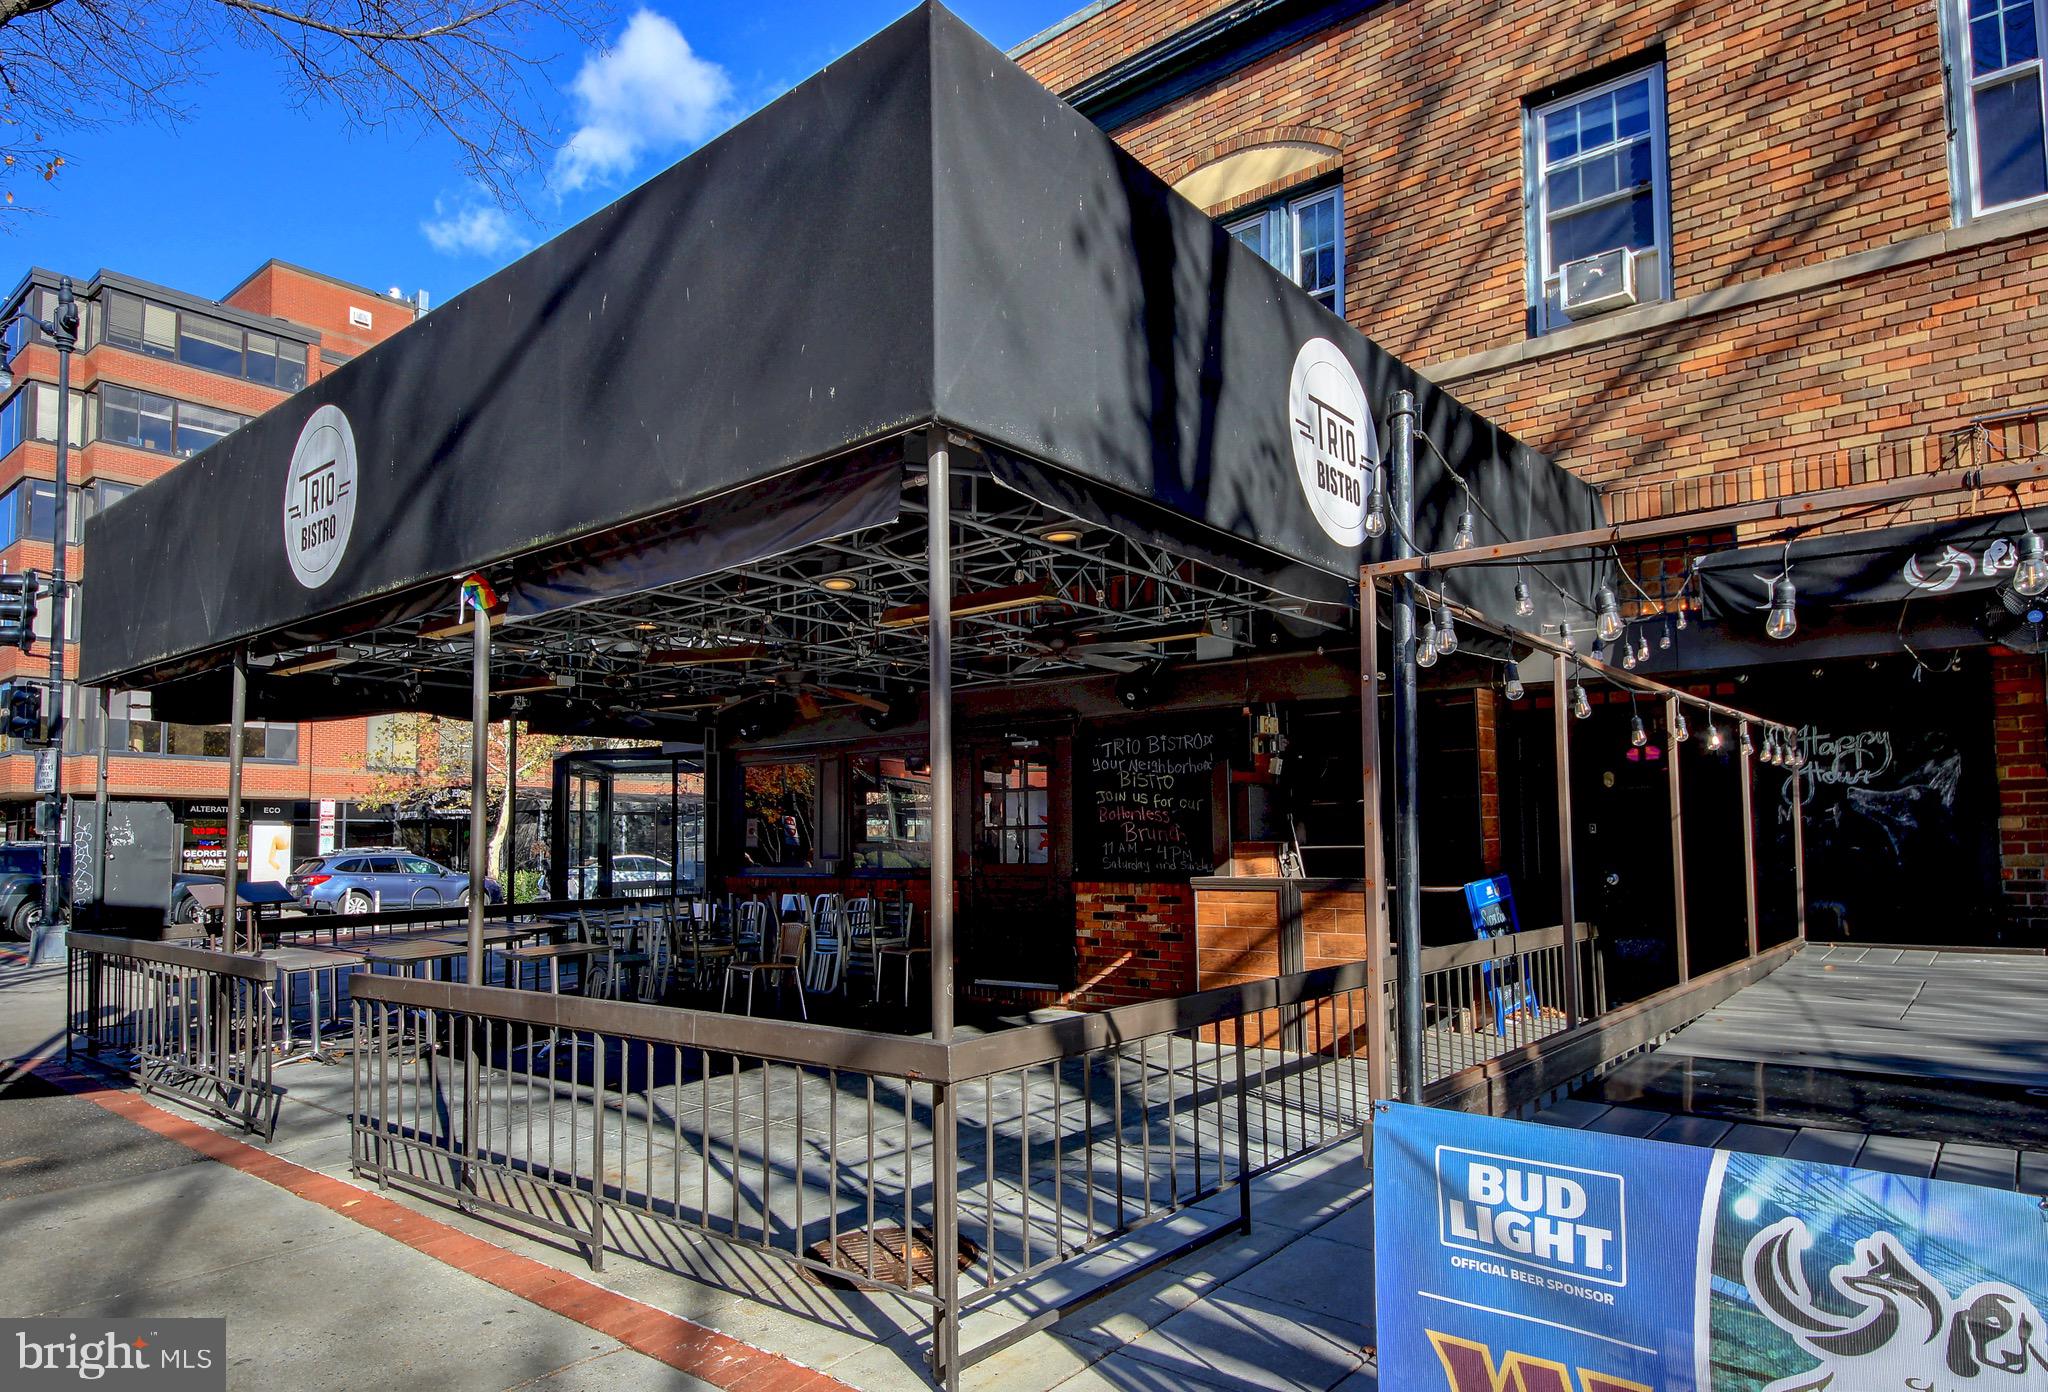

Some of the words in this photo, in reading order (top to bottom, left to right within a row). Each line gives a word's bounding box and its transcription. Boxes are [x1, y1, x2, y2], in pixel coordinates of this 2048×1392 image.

[1308, 393, 1356, 468] TRIO
[298, 459, 336, 517] TRIO
[1317, 459, 1361, 507] BISTRO
[301, 514, 336, 552] BISTRO
[1793, 724, 1893, 776] Happy
[190, 805, 245, 814] ALTERATIS
[263, 806, 281, 814] ECO
[1468, 1162, 1587, 1219] BUD
[1450, 1198, 1612, 1270] LIGHT
[1450, 1255, 1509, 1278] OFFICIAL
[1510, 1268, 1545, 1287] BEER
[1546, 1279, 1615, 1306] SPONSOR
